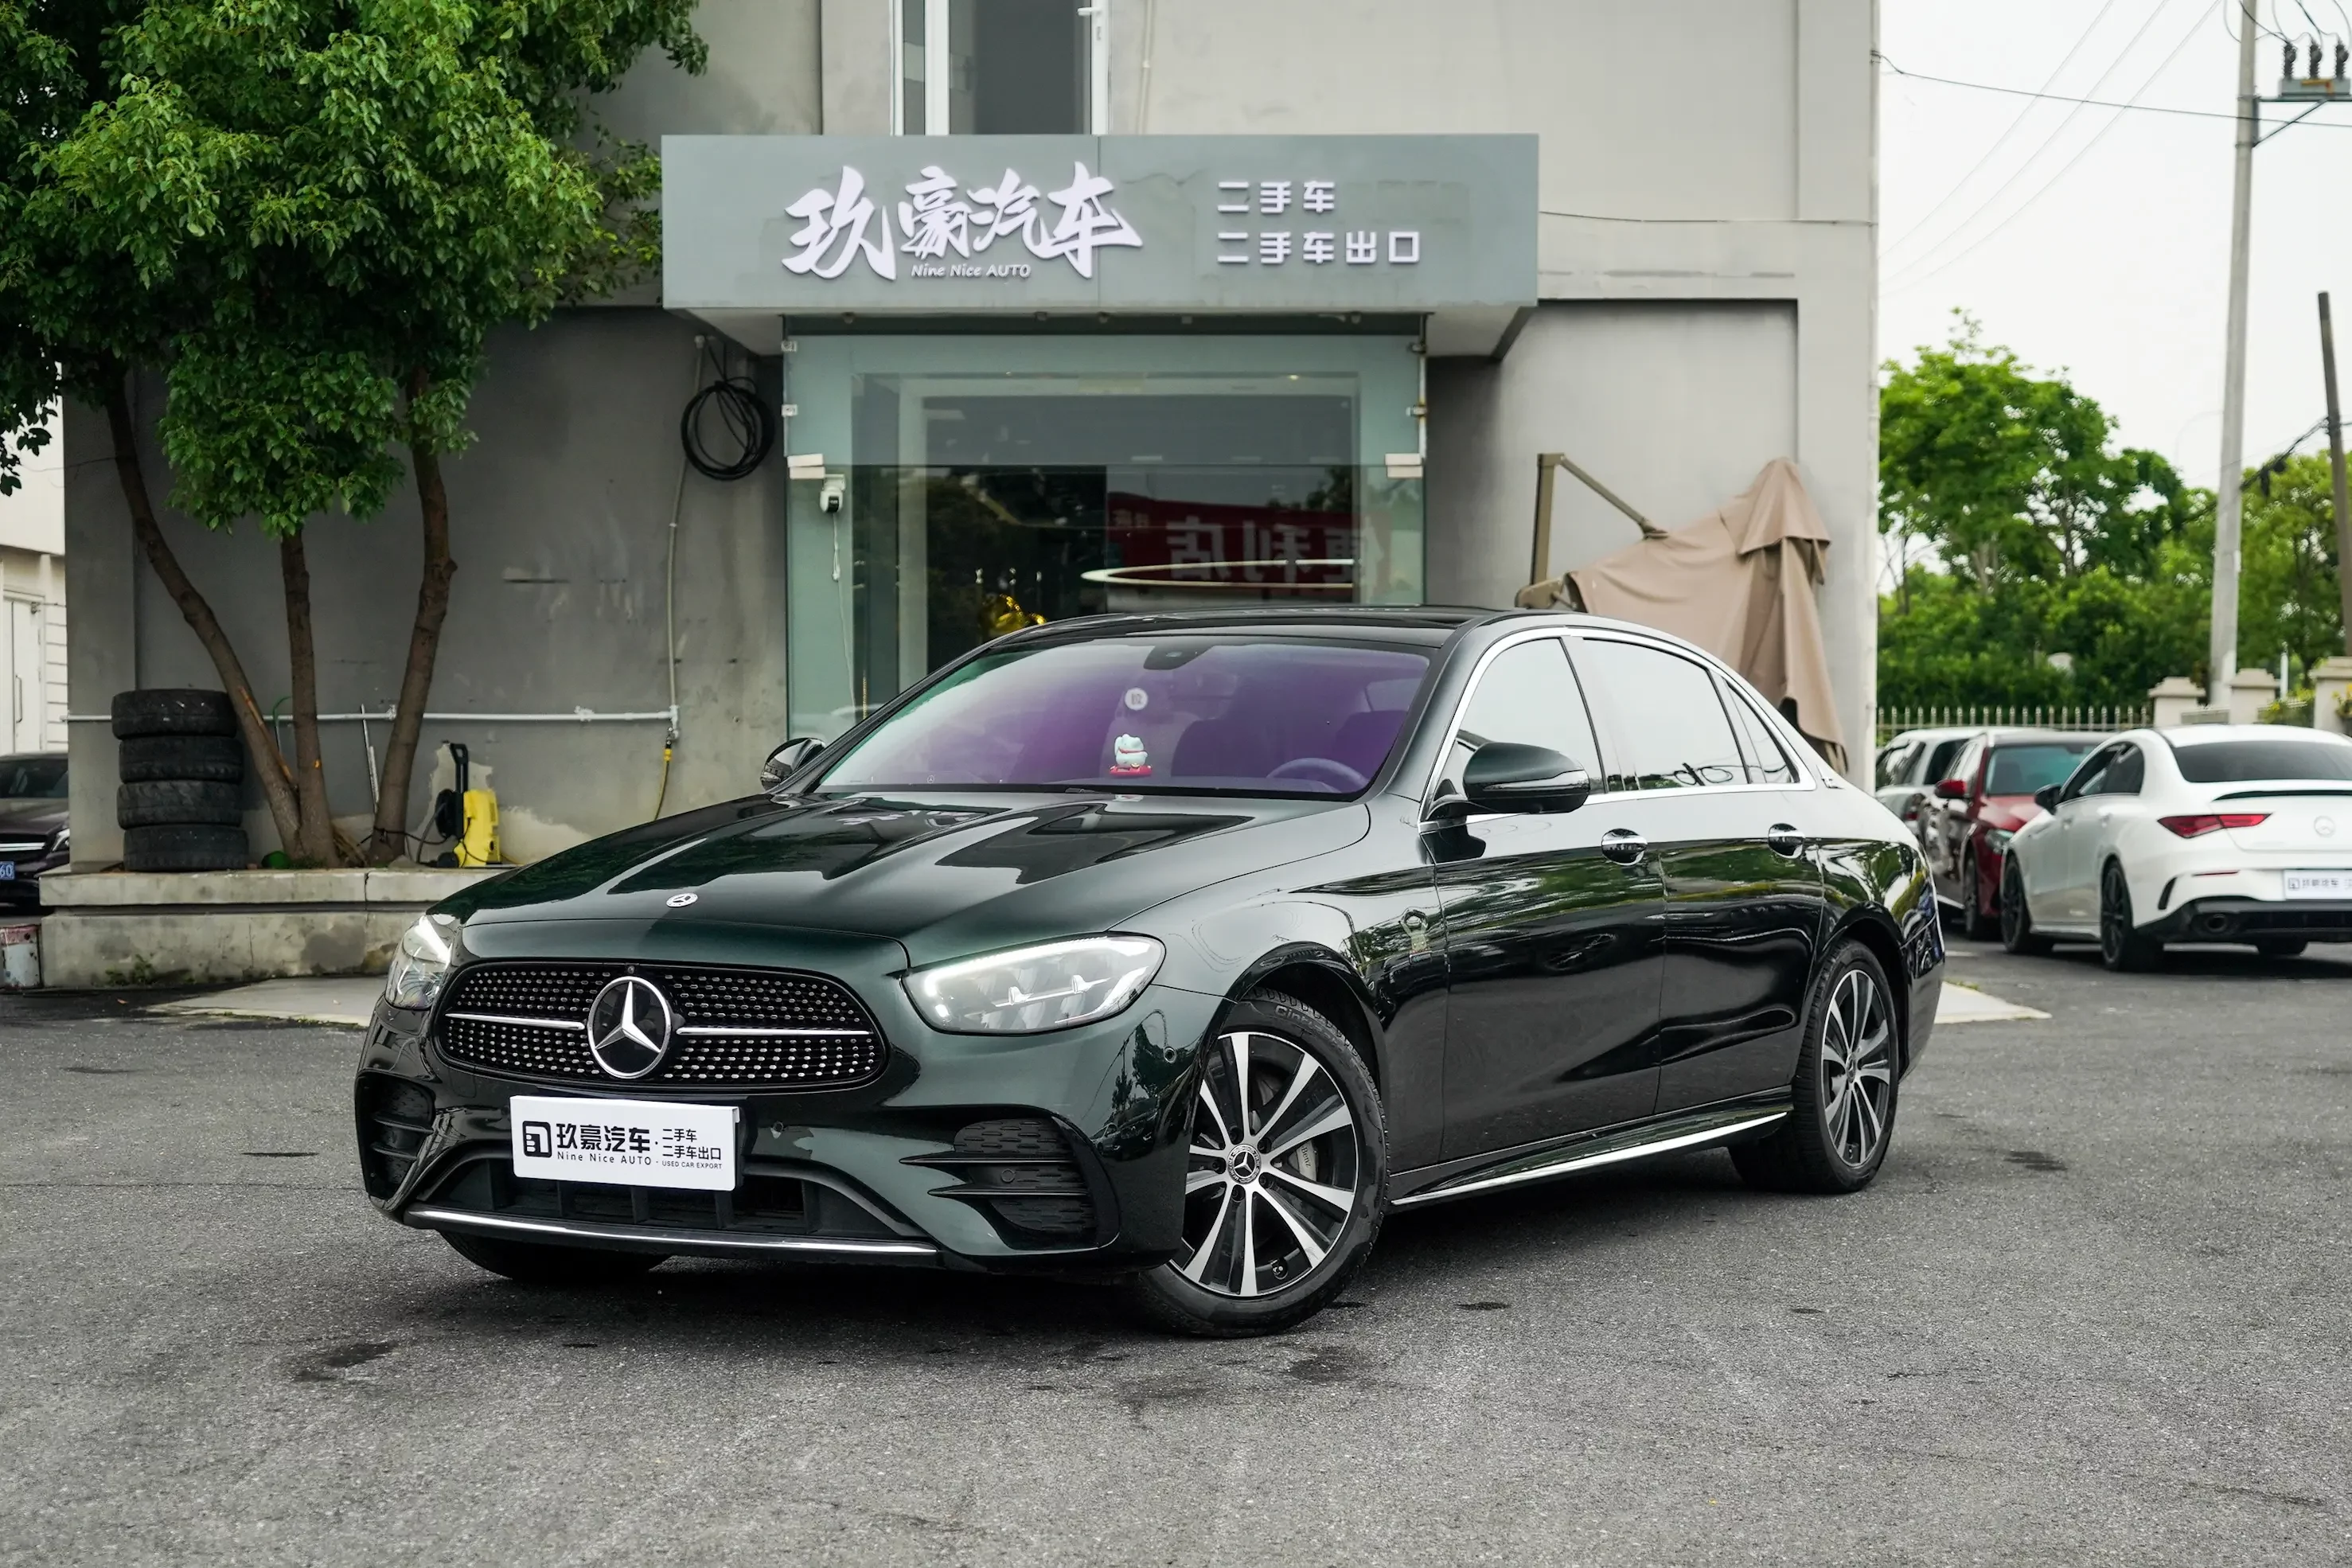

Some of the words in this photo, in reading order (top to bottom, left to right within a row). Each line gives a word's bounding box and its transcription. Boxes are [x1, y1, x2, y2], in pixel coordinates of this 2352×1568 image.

[1217, 180, 1336, 213] 二手车
[781, 161, 1144, 280] 玖豪汽车
[1217, 230, 1421, 264] 二手车出口
[911, 263, 946, 279] Nine
[950, 263, 982, 279] Nice
[986, 263, 1032, 279] AUTO
[556, 1123, 650, 1153] 玖豪汽车
[662, 1129, 697, 1142] 二手车
[557, 1151, 583, 1161] Nine
[589, 1153, 614, 1163] Nice
[621, 1155, 652, 1165] AUTO
[662, 1145, 721, 1160] 二手车出口
